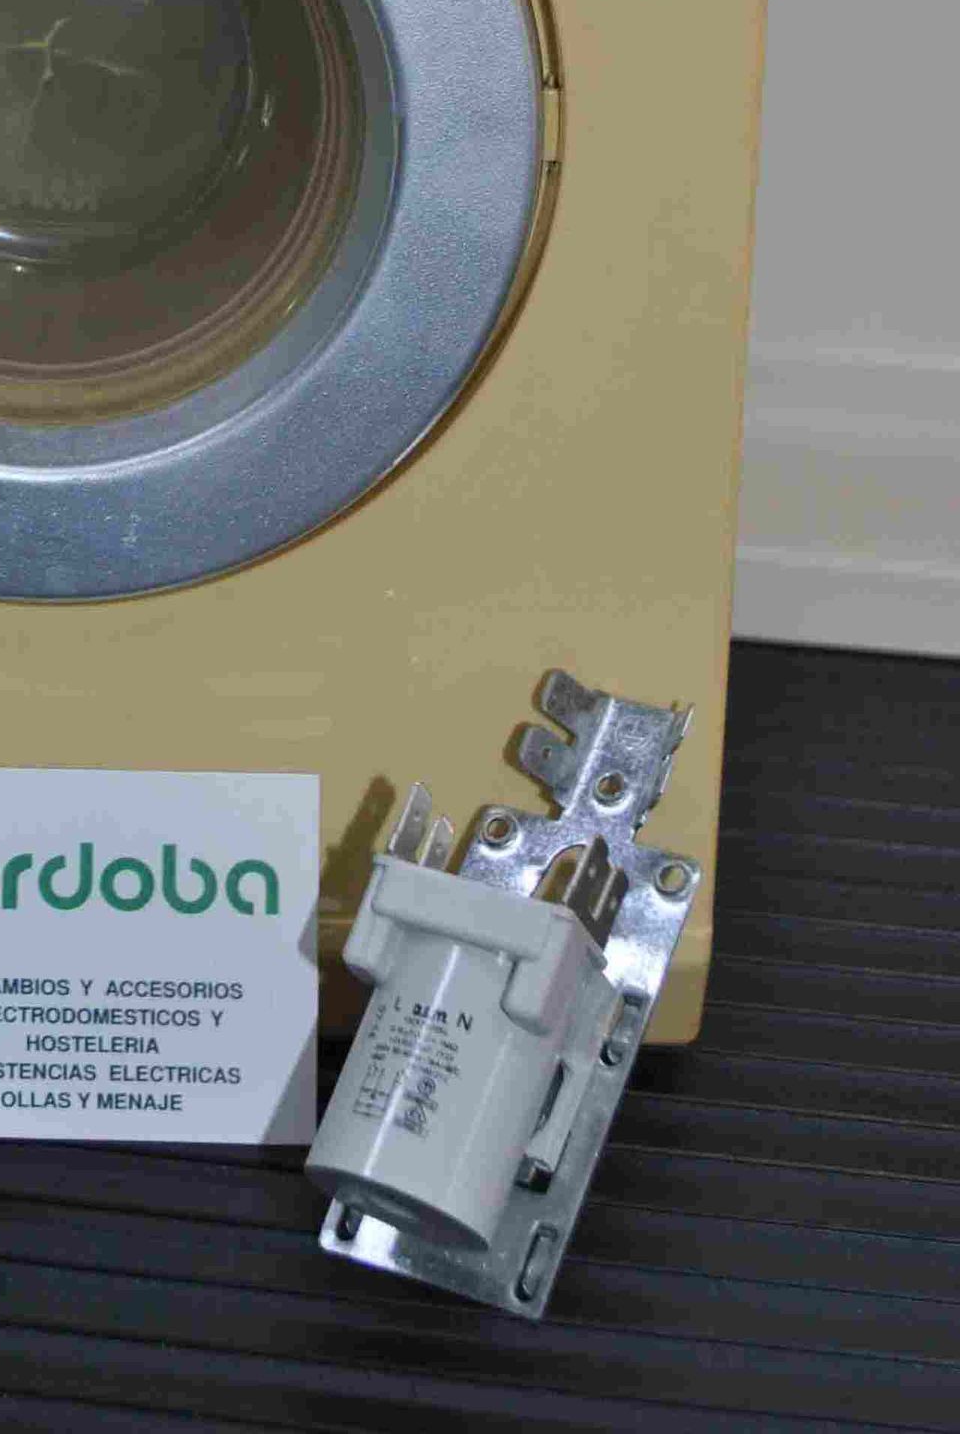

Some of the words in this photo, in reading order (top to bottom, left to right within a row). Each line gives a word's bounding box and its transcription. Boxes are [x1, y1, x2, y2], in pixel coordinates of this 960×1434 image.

[80, 979, 93, 996] Y
[105, 980, 243, 1000] ACCESORIOS
[210, 1010, 224, 1027] Y
[455, 1012, 474, 1032] N
[26, 1036, 159, 1054] HOSTELERIA
[109, 1065, 241, 1084] ELECTRICAS
[0, 1091, 70, 1109] OLLAS
[77, 1092, 90, 1109] Y
[96, 1093, 183, 1111] MENAJE
